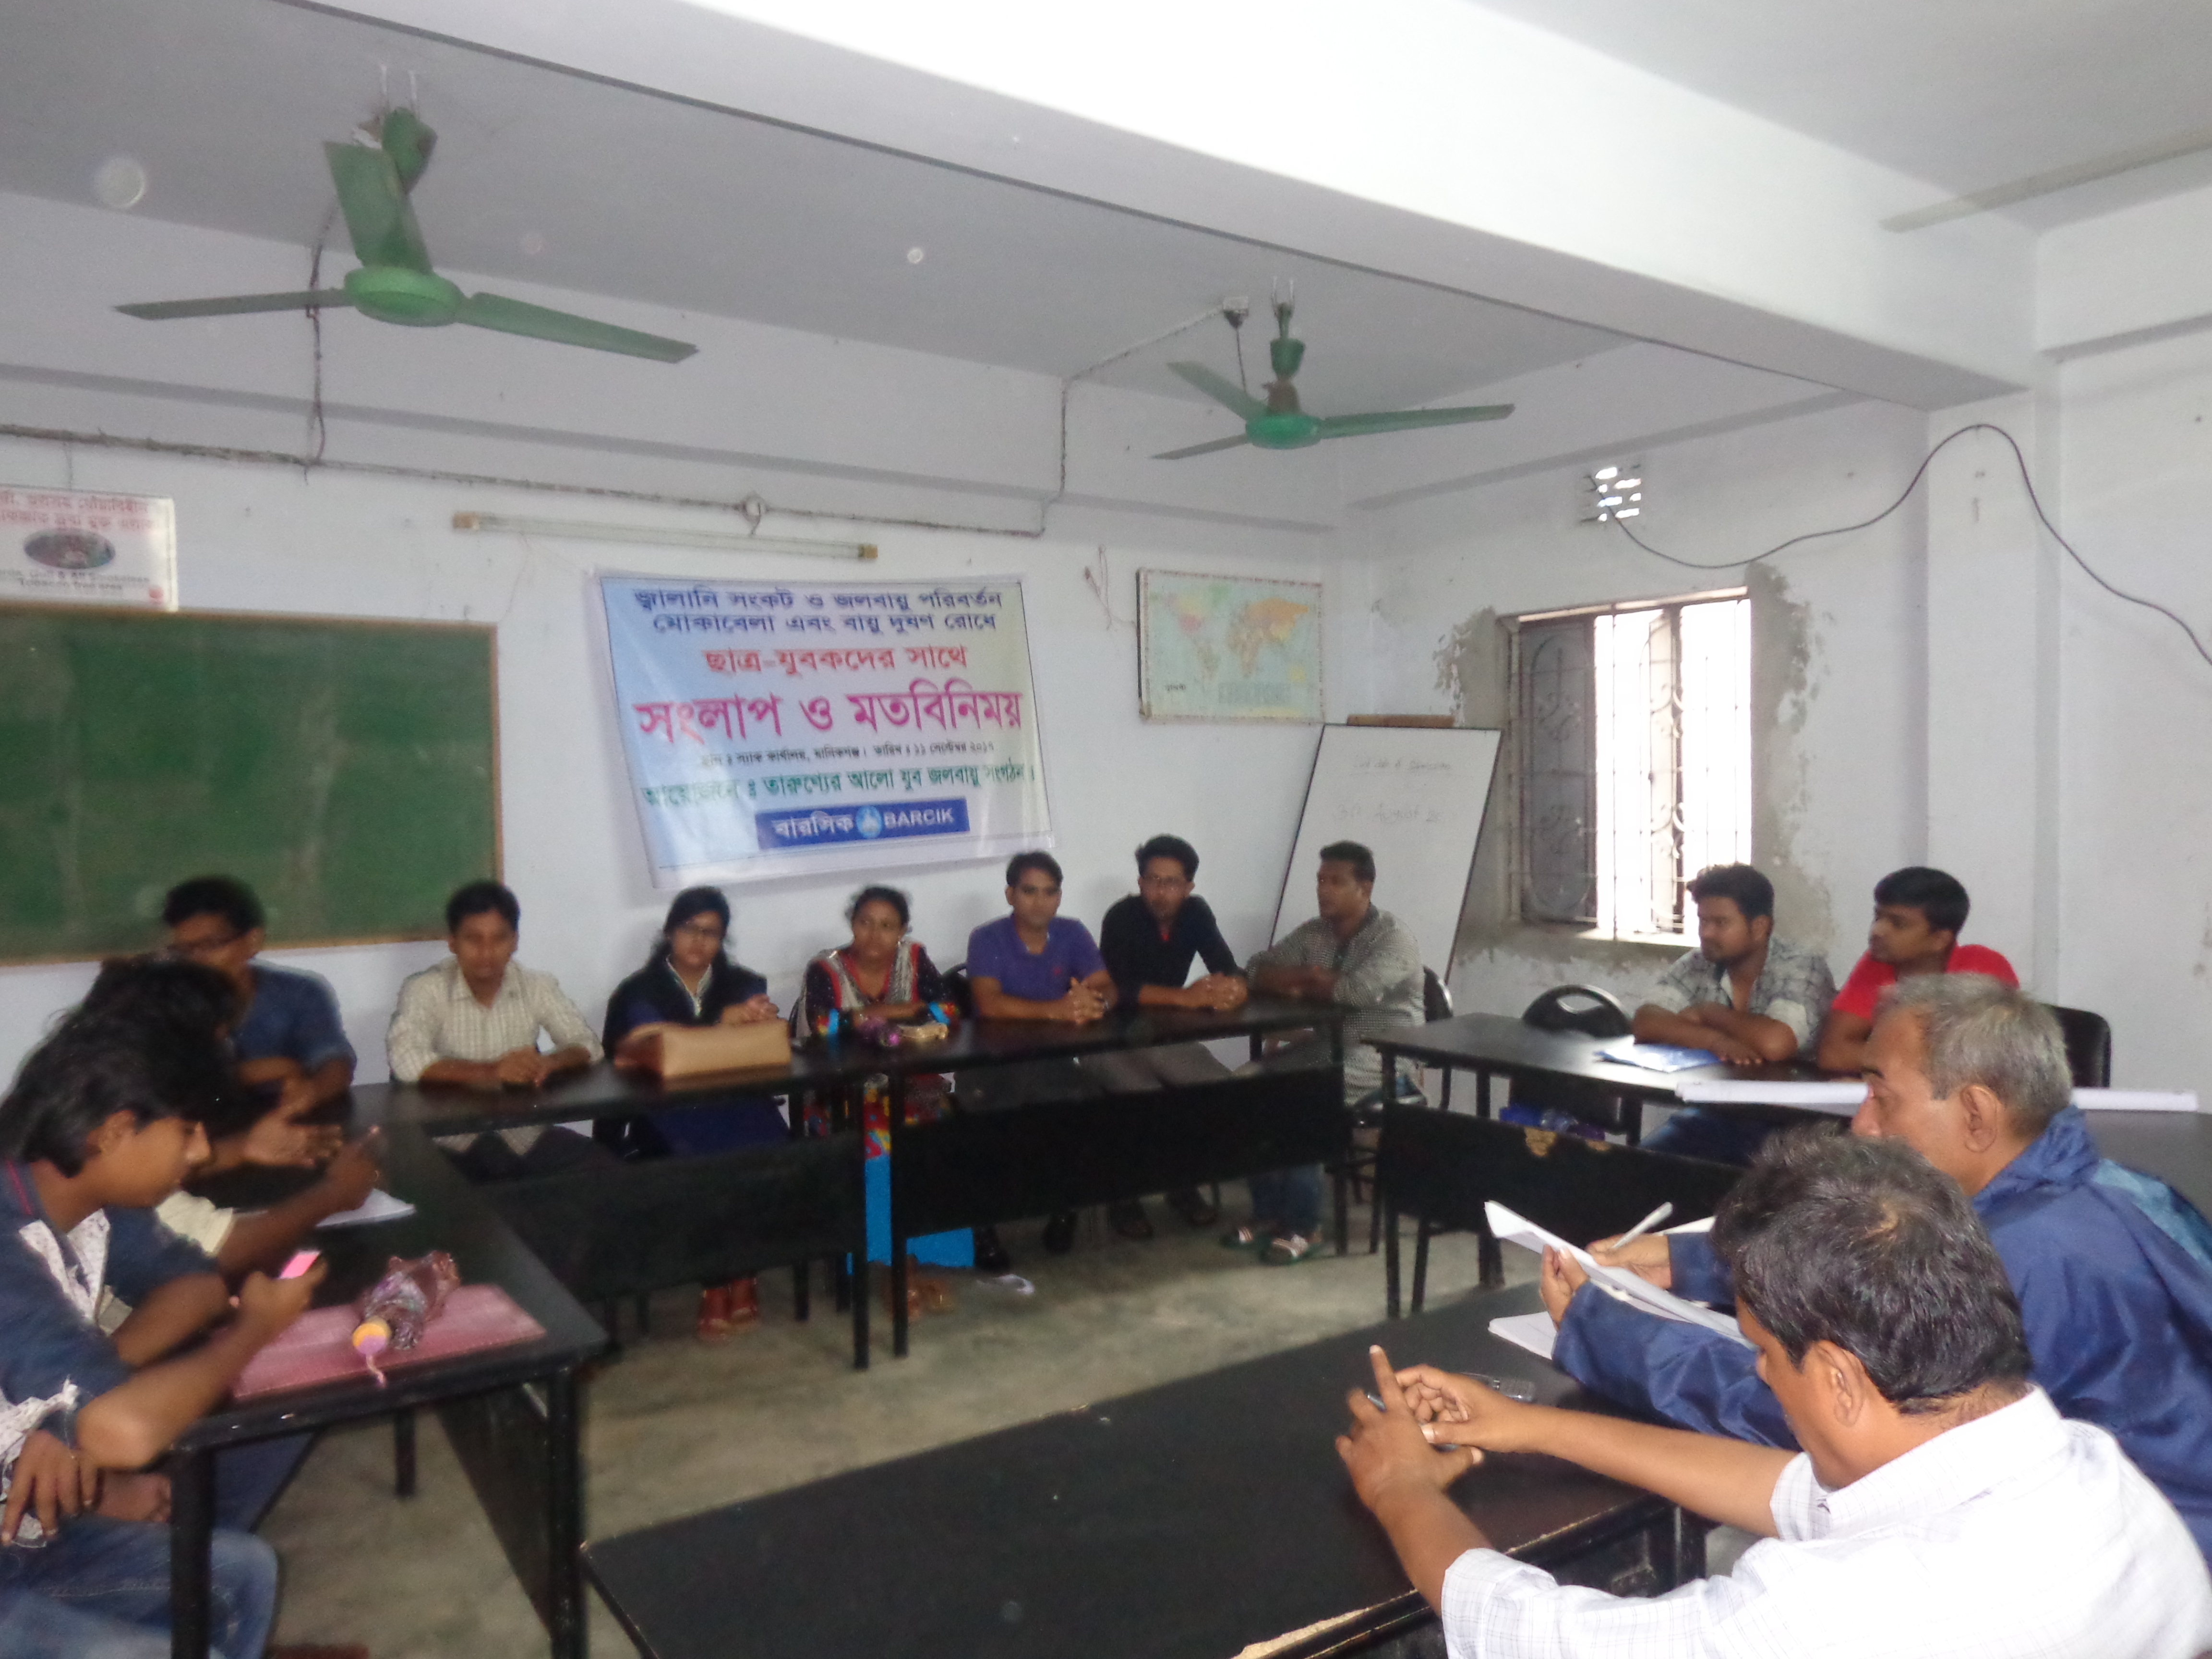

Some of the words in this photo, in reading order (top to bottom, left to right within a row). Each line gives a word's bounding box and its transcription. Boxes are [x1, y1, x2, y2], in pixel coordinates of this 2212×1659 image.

[634, 585, 718, 610] জ্বালানি
[726, 586, 794, 610] সংকট
[805, 593, 823, 609] ও
[831, 591, 910, 612] জলবায়ু
[919, 587, 1002, 608] পরিবর্তন
[653, 613, 774, 633] মোকাবেলা
[786, 614, 836, 634] এবং
[840, 613, 884, 635] বায়ু
[904, 644, 967, 669] সাথে
[633, 692, 783, 745] সংলাপ
[799, 696, 833, 731] ও
[846, 677, 1023, 733] মতবিনিময়
[846, 769, 894, 790] আলো
[899, 767, 922, 791] যুব
[926, 765, 982, 787] জলবায়ু
[771, 810, 854, 839] বারসিক
[884, 807, 955, 830] BARCIK
